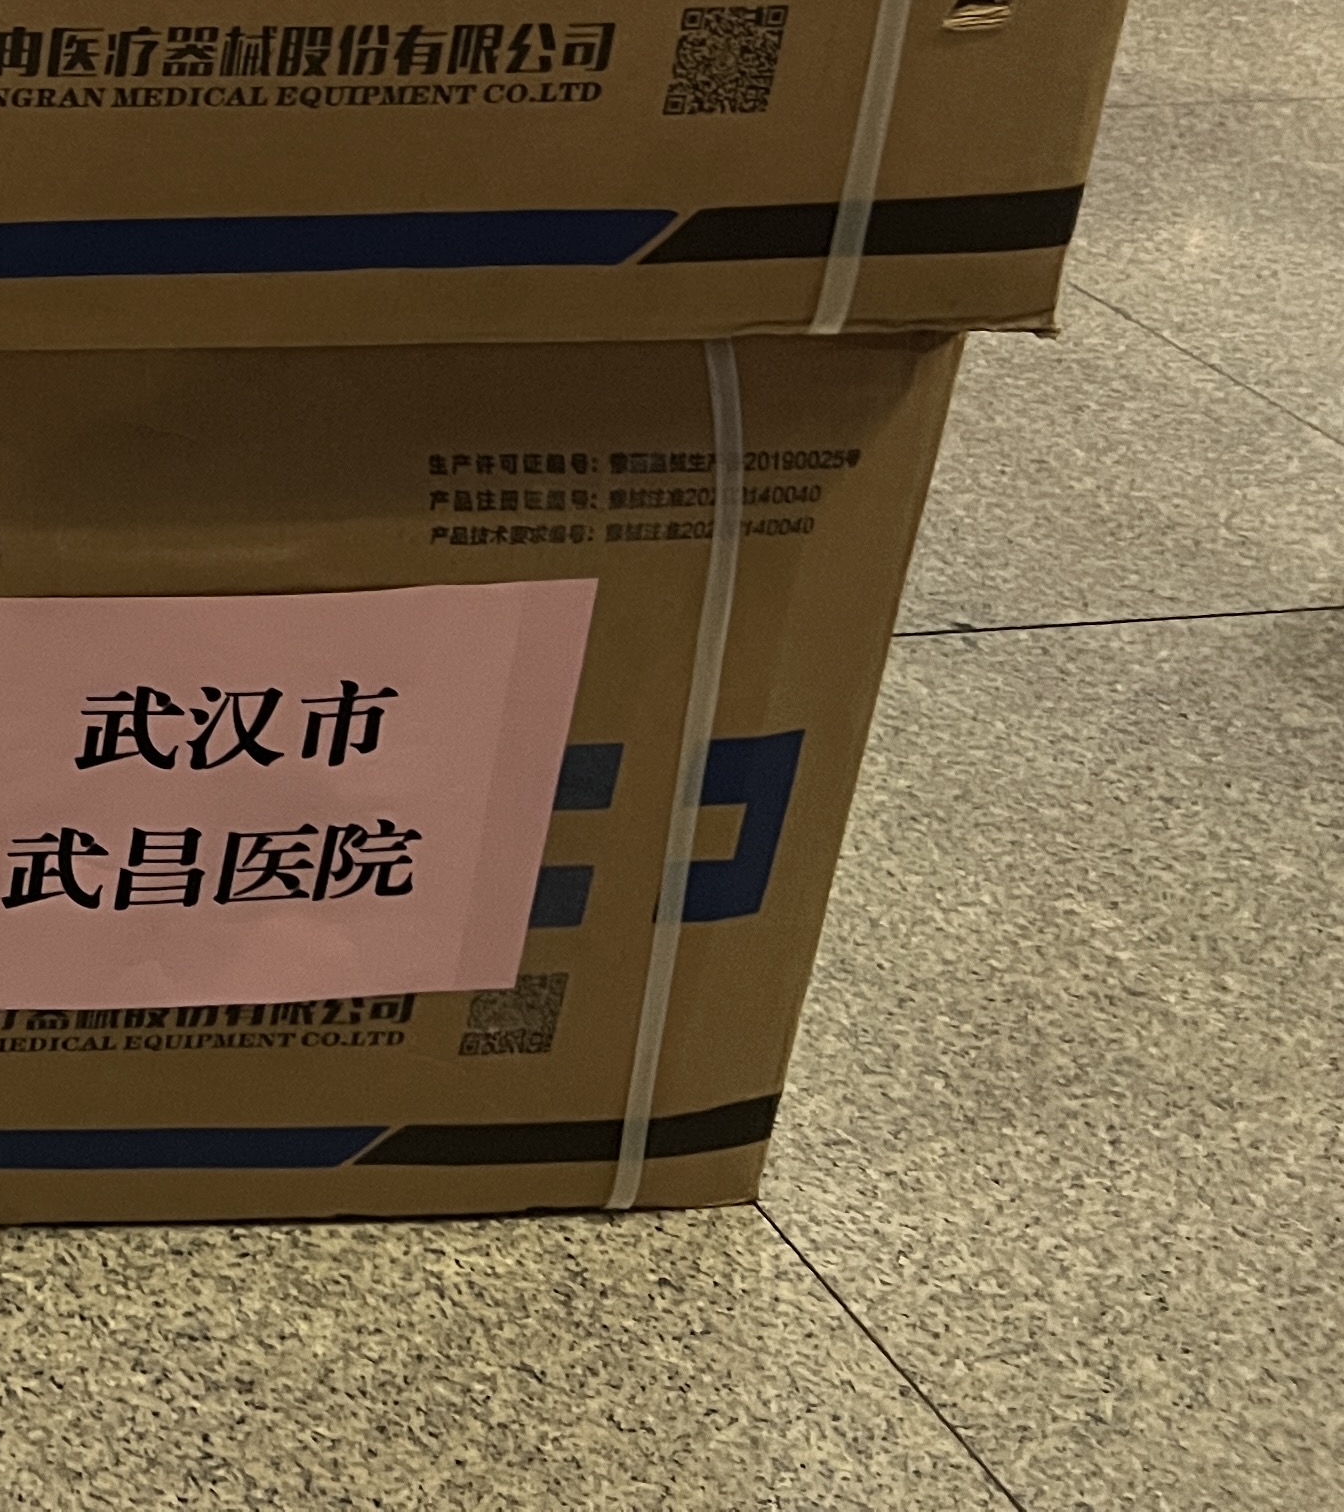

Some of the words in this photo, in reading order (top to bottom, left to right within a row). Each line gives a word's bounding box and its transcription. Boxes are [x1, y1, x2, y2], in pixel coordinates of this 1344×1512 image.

[110, 86, 268, 108] MEDICAL
[275, 84, 477, 108] EQUIPMENT
[74, 679, 399, 771] 武汉市
[1, 818, 422, 911] 武昌医院
[123, 1032, 297, 1051] EQUIPMENT
